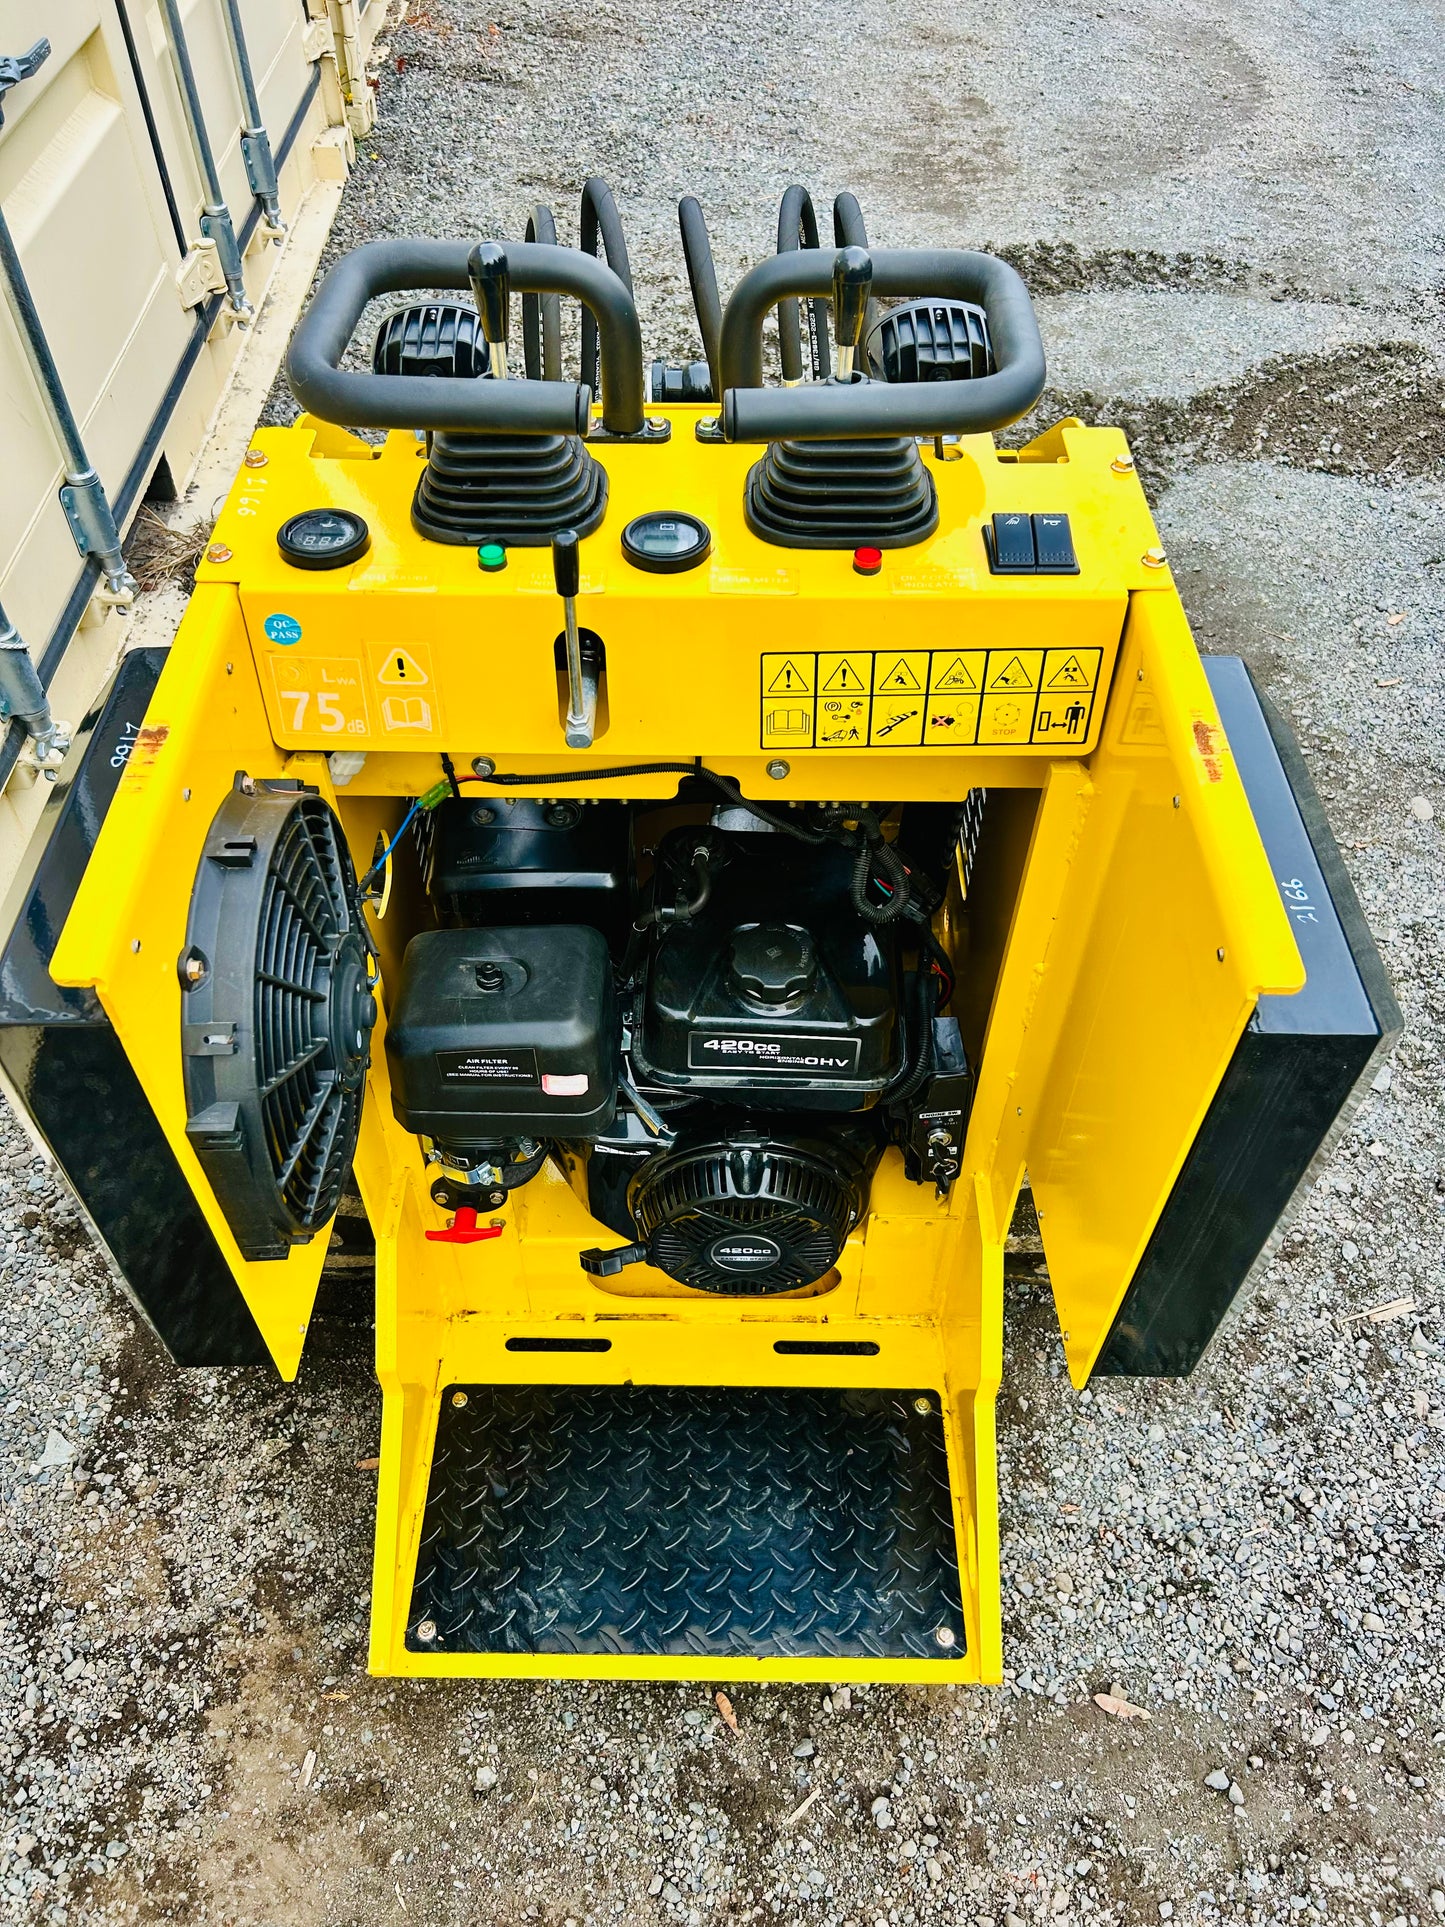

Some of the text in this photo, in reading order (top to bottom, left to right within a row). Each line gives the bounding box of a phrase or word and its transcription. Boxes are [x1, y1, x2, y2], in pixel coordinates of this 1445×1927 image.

[273, 620, 290, 629] QC
[270, 631, 299, 639] PASS
[280, 690, 367, 734] 75 dB
[991, 728, 1017, 736] STOP
[703, 1039, 781, 1051] 420cc
[804, 1057, 850, 1067] OHV
